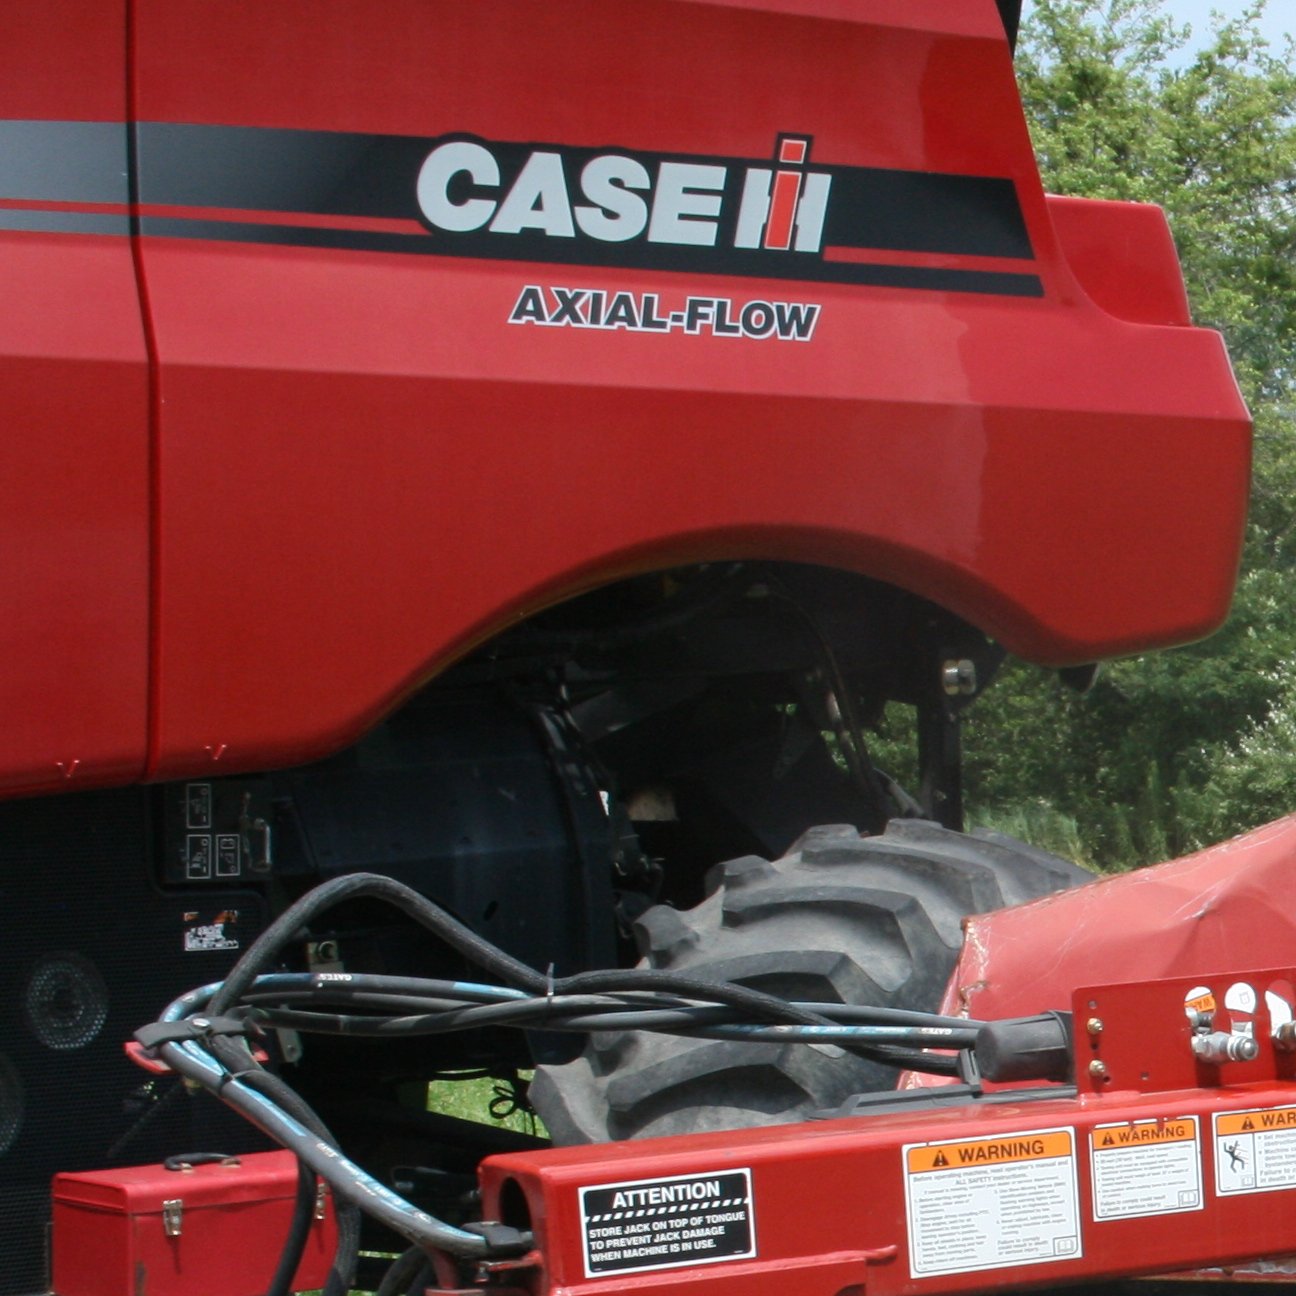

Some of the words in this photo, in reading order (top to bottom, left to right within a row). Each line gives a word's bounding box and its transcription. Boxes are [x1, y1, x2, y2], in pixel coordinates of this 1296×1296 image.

[415, 140, 728, 247] CASE
[508, 285, 822, 341] AXIAL-FLOW
[1118, 1125, 1186, 1143] WARNING
[958, 1140, 1045, 1163] WARNING
[612, 1180, 721, 1209] ATTENTION
[589, 1225, 622, 1239] STORE
[624, 1222, 650, 1235] JACK
[652, 1219, 667, 1231] ON
[669, 1217, 688, 1229] TOP
[690, 1215, 703, 1226] OF
[705, 1211, 745, 1225] TONGUE
[590, 1239, 604, 1250] TO
[606, 1234, 652, 1248] PREVENT
[653, 1232, 680, 1244] JACK
[682, 1225, 725, 1239] DAMAGE
[591, 1250, 621, 1262] WHEN
[623, 1245, 668, 1259] MACHINE
[669, 1243, 680, 1252] IS
[681, 1241, 692, 1251] IN
[694, 1239, 716, 1250] USE.
